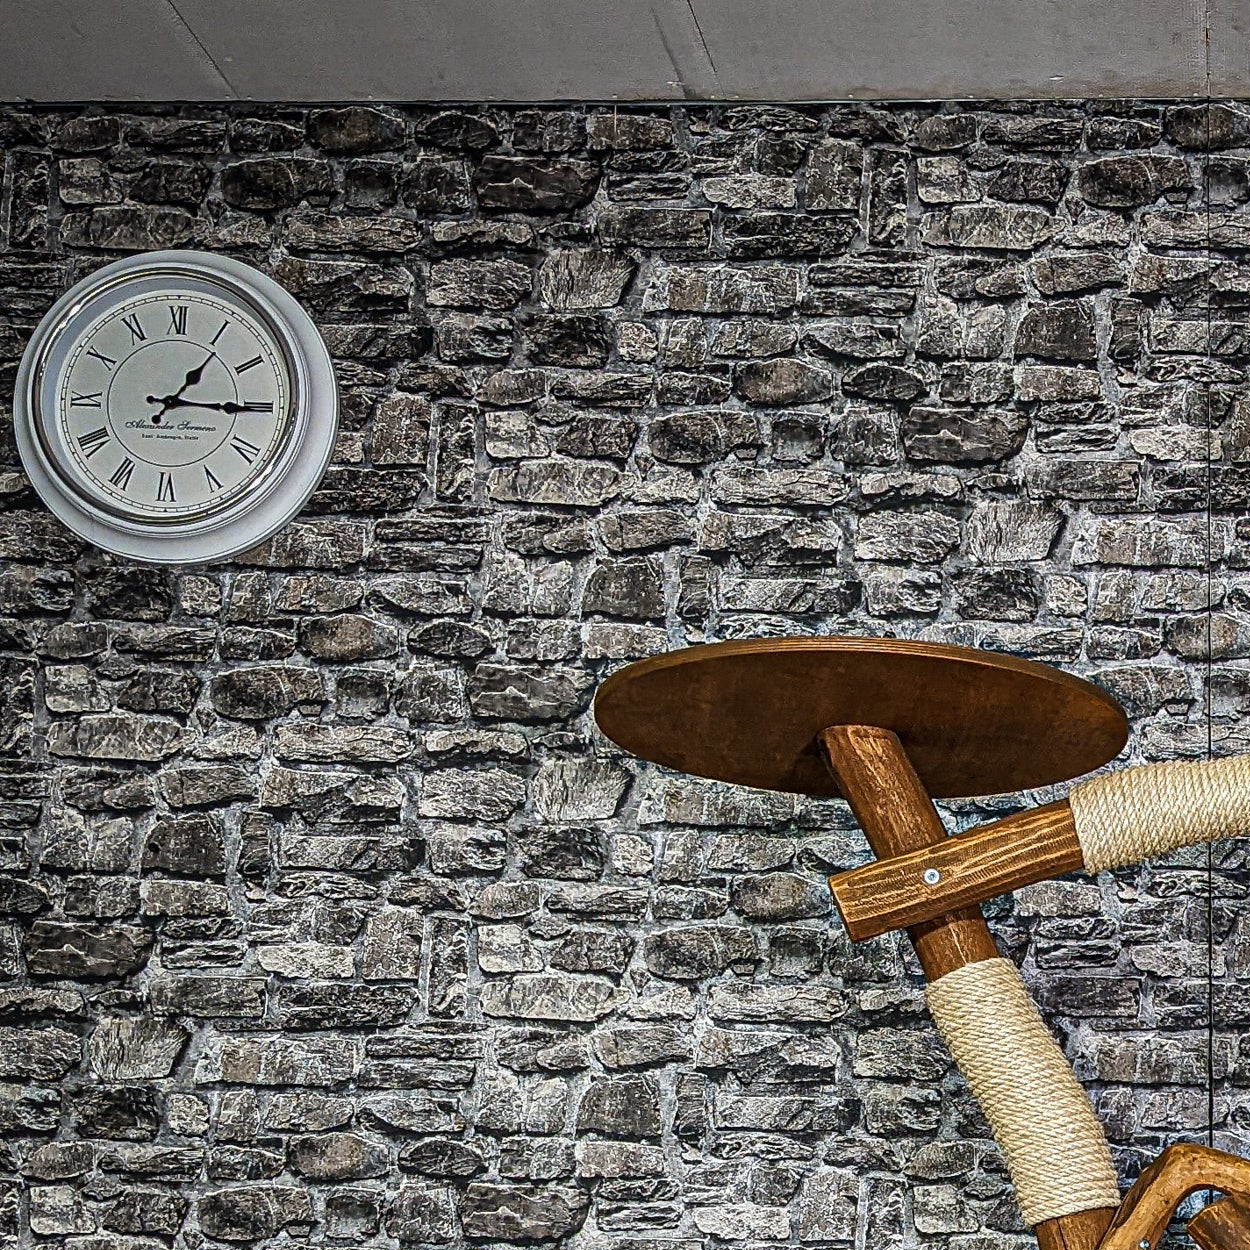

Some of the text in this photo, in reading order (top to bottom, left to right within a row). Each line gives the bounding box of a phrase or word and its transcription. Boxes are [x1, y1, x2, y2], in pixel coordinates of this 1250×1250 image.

[121, 312, 148, 346] XI
[166, 305, 190, 336] XII
[209, 319, 231, 347] I
[86, 346, 117, 371] X
[234, 354, 265, 376] II
[70, 390, 103, 409] IX
[77, 425, 112, 460] VIII
[229, 434, 262, 466] IV
[108, 456, 136, 492] VII
[155, 471, 177, 503] VI
[203, 464, 225, 494] V
